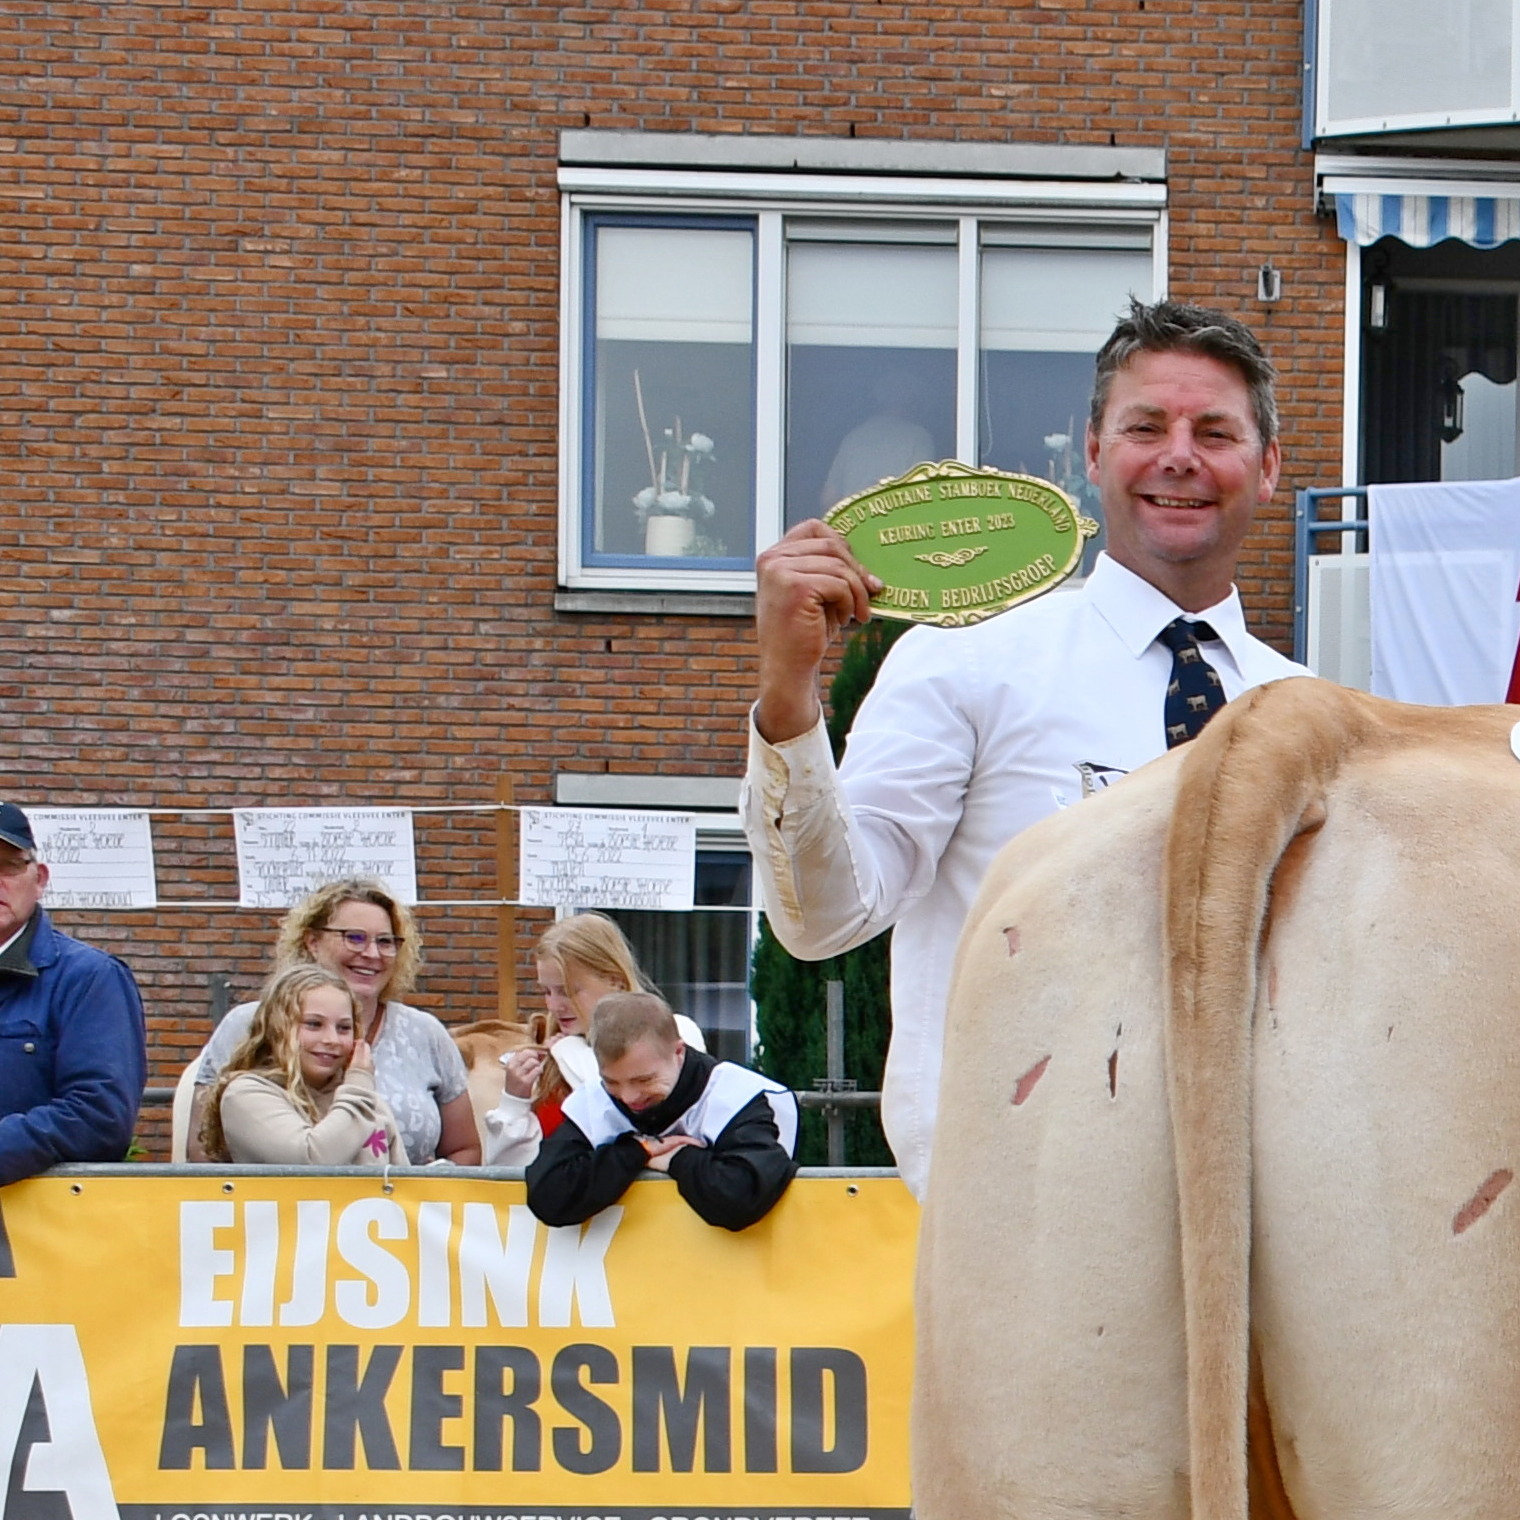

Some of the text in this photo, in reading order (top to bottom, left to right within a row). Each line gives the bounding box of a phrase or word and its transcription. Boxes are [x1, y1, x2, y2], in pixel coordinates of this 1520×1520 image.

[854, 486, 932, 521] D'AQUITAINE
[940, 483, 1002, 500] STAMBOEK
[1008, 483, 1072, 533] NEDERLAND
[880, 512, 1016, 546] KEURING ENTER 2023
[873, 553, 1058, 609] PIOEN BEDRIJFSGROEP
[178, 1198, 625, 1330] EIJSINK
[158, 1343, 869, 1475] ANKERSMID
